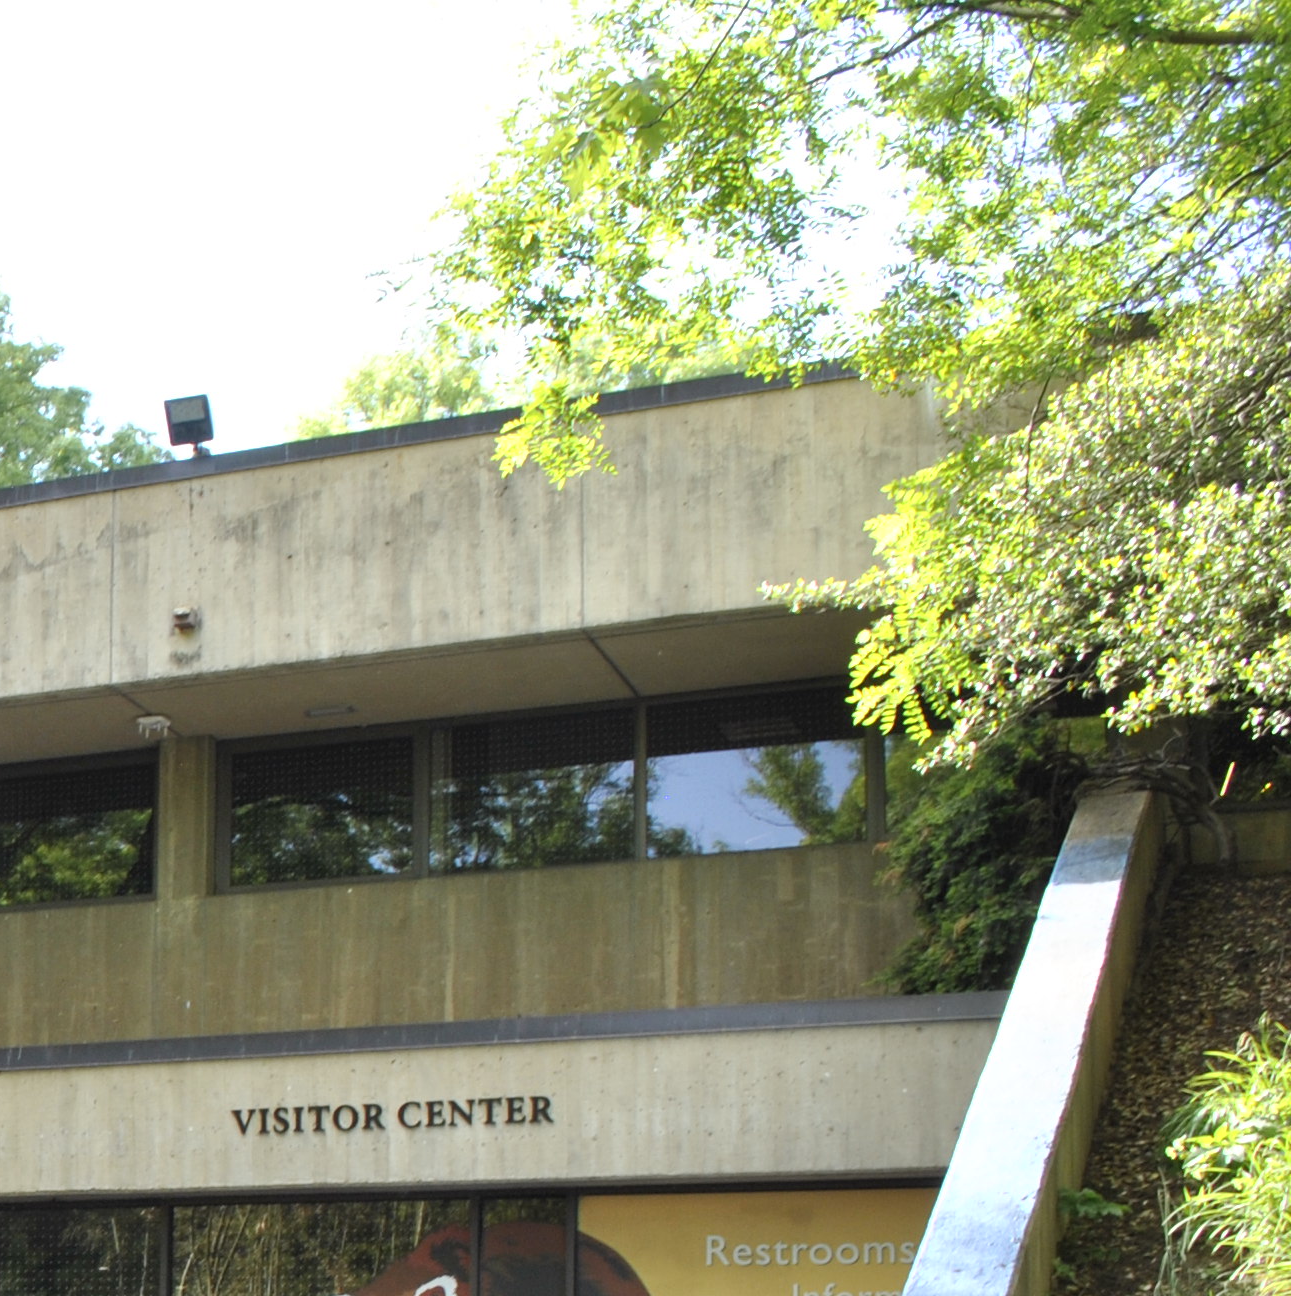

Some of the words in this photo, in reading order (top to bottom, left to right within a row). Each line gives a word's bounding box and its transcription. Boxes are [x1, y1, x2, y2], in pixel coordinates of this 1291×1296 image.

[231, 1103, 386, 1135] VISITOR
[397, 1096, 554, 1129] CENTER
[705, 1235, 917, 1266] Restrooms
